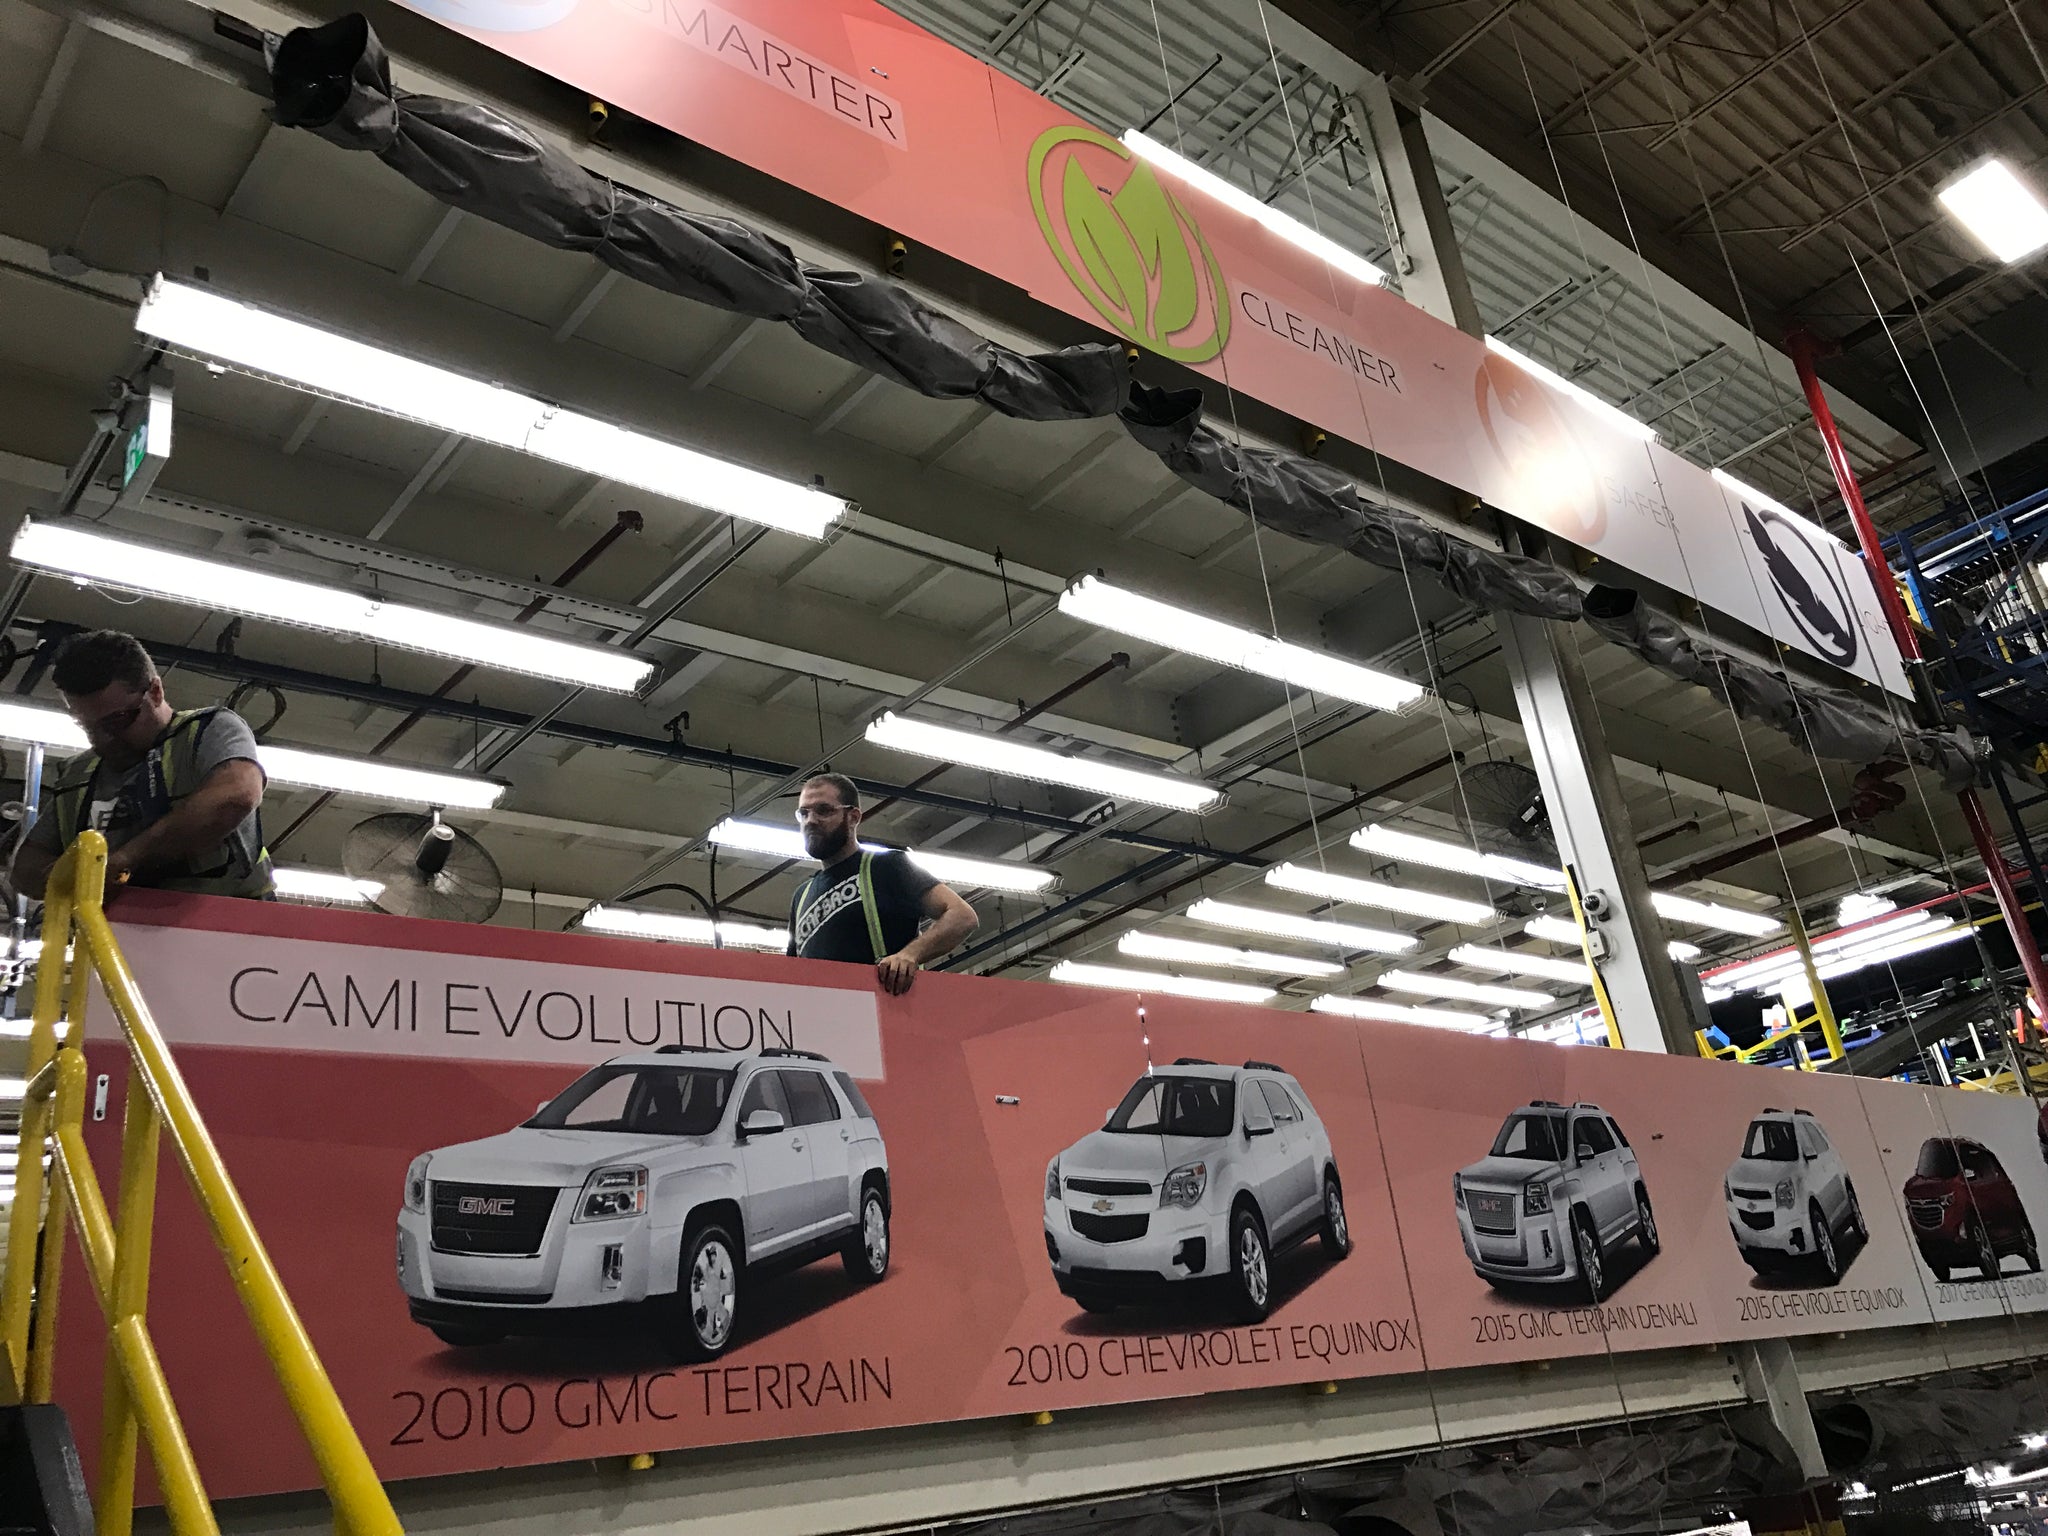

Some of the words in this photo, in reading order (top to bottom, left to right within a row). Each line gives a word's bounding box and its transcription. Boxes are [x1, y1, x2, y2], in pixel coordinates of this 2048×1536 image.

[1240, 291, 1402, 393] CLEANER
[1604, 476, 1680, 535] SAFER
[229, 967, 418, 1031] CAMI
[443, 983, 794, 1050] EVOLUTION
[458, 1196, 515, 1216] GMC
[1470, 1314, 1517, 1343] 2015
[1518, 1310, 1563, 1339] GMC
[1563, 1305, 1636, 1335] TERRAIN
[1636, 1301, 1698, 1329] DENALI
[1735, 1294, 1772, 1322] 2015
[1772, 1289, 1855, 1320] CHEVROLET
[1854, 1287, 1909, 1316] EQUINOX
[1004, 1341, 1089, 1387] 2010
[1098, 1326, 1284, 1377] CHEVROLET
[1293, 1317, 1416, 1365] EQUINOX
[389, 1382, 536, 1446] 2010
[554, 1372, 678, 1430] GMC
[691, 1356, 893, 1418] TERRAIN
